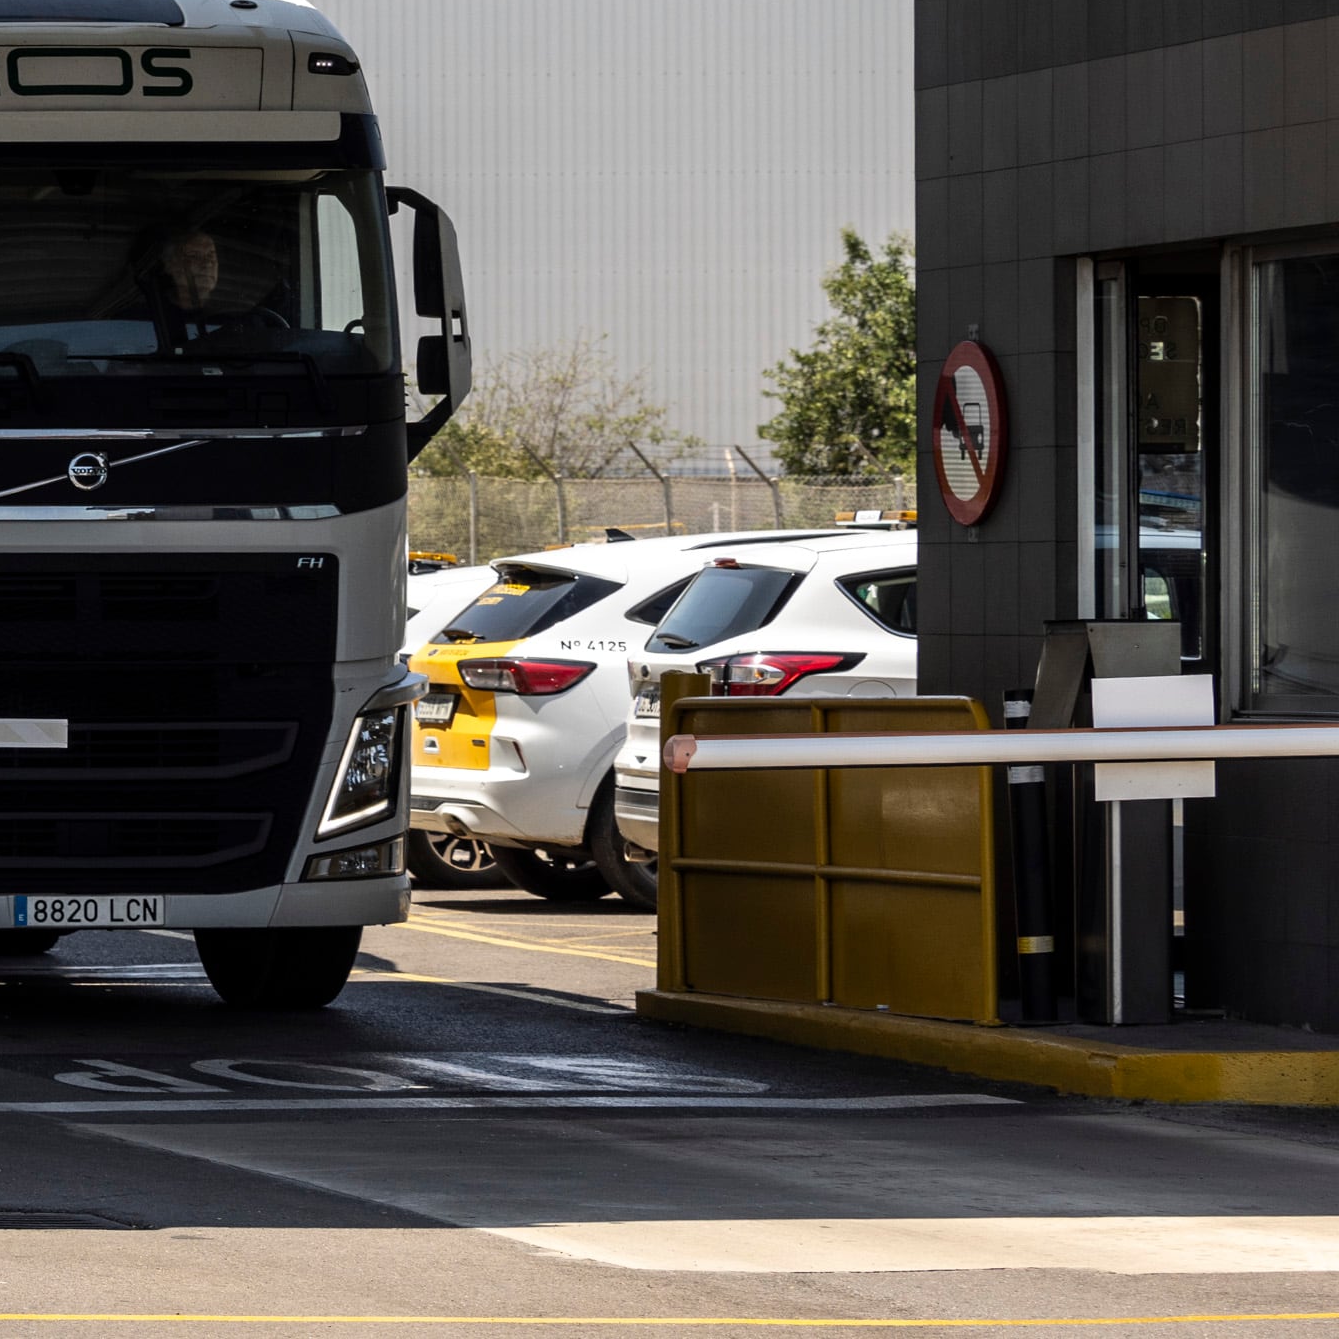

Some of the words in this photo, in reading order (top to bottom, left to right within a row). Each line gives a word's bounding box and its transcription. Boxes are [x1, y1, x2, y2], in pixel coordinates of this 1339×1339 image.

[296, 557, 324, 569] FH
[587, 640, 627, 652] 4125
[34, 899, 98, 923] 8820
[110, 898, 157, 923] LCN
